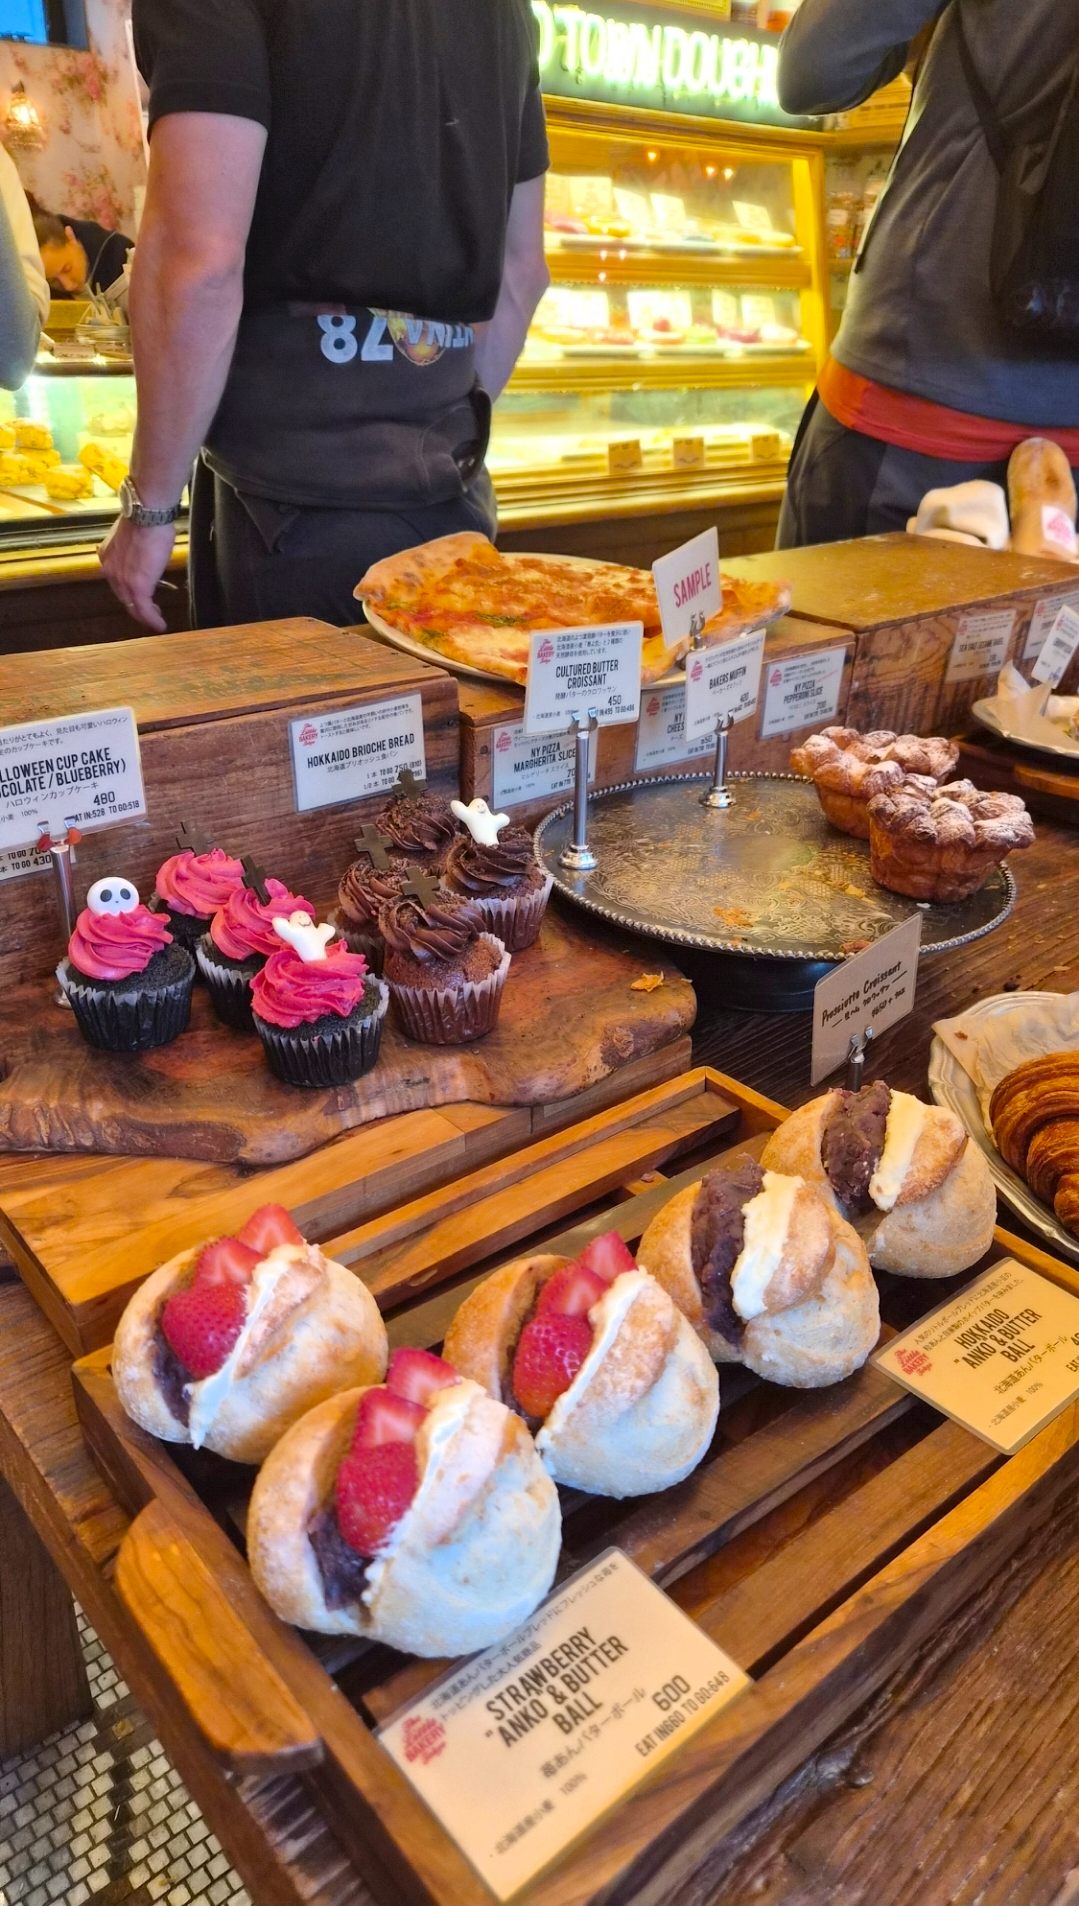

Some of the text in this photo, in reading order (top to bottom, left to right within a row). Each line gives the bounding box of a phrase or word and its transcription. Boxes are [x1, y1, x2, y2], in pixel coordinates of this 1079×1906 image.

[553, 8, 662, 89] TOWN
[317, 314, 393, 363] 78
[673, 562, 712, 608] SAMPLE
[556, 659, 619, 678] CULTURED BUTTER
[567, 674, 607, 690] CROISSANT
[709, 665, 747, 690] BAKERS MUFFIN
[607, 695, 622, 706] 450
[298, 733, 318, 743] BAKERY
[667, 721, 685, 734] CHEES
[307, 733, 415, 769] HOKKAIDO BRIOCHE BREAD
[514, 748, 576, 773] MARGHERITA SLICE
[530, 742, 561, 758] NY PIZZA
[0, 747, 112, 782] LLOWEEN CUP CAKE
[395, 762, 408, 774] 750
[0, 776, 46, 799] COLATE
[57, 758, 126, 787] BLUEBERRY)
[6, 782, 99, 809] ハロウィンカップケーキ
[93, 791, 116, 806] 480
[0, 808, 39, 824] 小麦 100%
[83, 808, 106, 821] IN:528
[108, 805, 117, 815] TO
[117, 799, 140, 813] GO:518
[7, 852, 16, 860] TO
[16, 849, 27, 858] GO
[29, 847, 48, 857] 70
[11, 862, 20, 871] TO
[21, 860, 31, 868] GO
[33, 854, 52, 866] 430
[821, 961, 902, 1028] Prosciutto Croissant
[953, 1308, 1010, 1350] HOKKAIDO
[990, 1333, 1006, 1348] &
[1002, 1308, 1043, 1340] BUTTER
[1000, 1337, 1036, 1363] BALL
[903, 1353, 930, 1376] BAKERY
[993, 1335, 1068, 1395] 北海道あんバターボール
[1025, 1381, 1043, 1396] 100%
[486, 1626, 597, 1721] STRAWBERRY
[546, 1684, 567, 1705] &
[560, 1635, 630, 1694] BUTTER
[651, 1674, 691, 1712] 600
[552, 1691, 604, 1735] BALL
[634, 1733, 658, 1758] EAT
[681, 1698, 699, 1716] TO
[698, 1669, 730, 1706] GO:648
[403, 1722, 448, 1762] BAKERY
[541, 1687, 647, 1778] 苺あんバターボール
